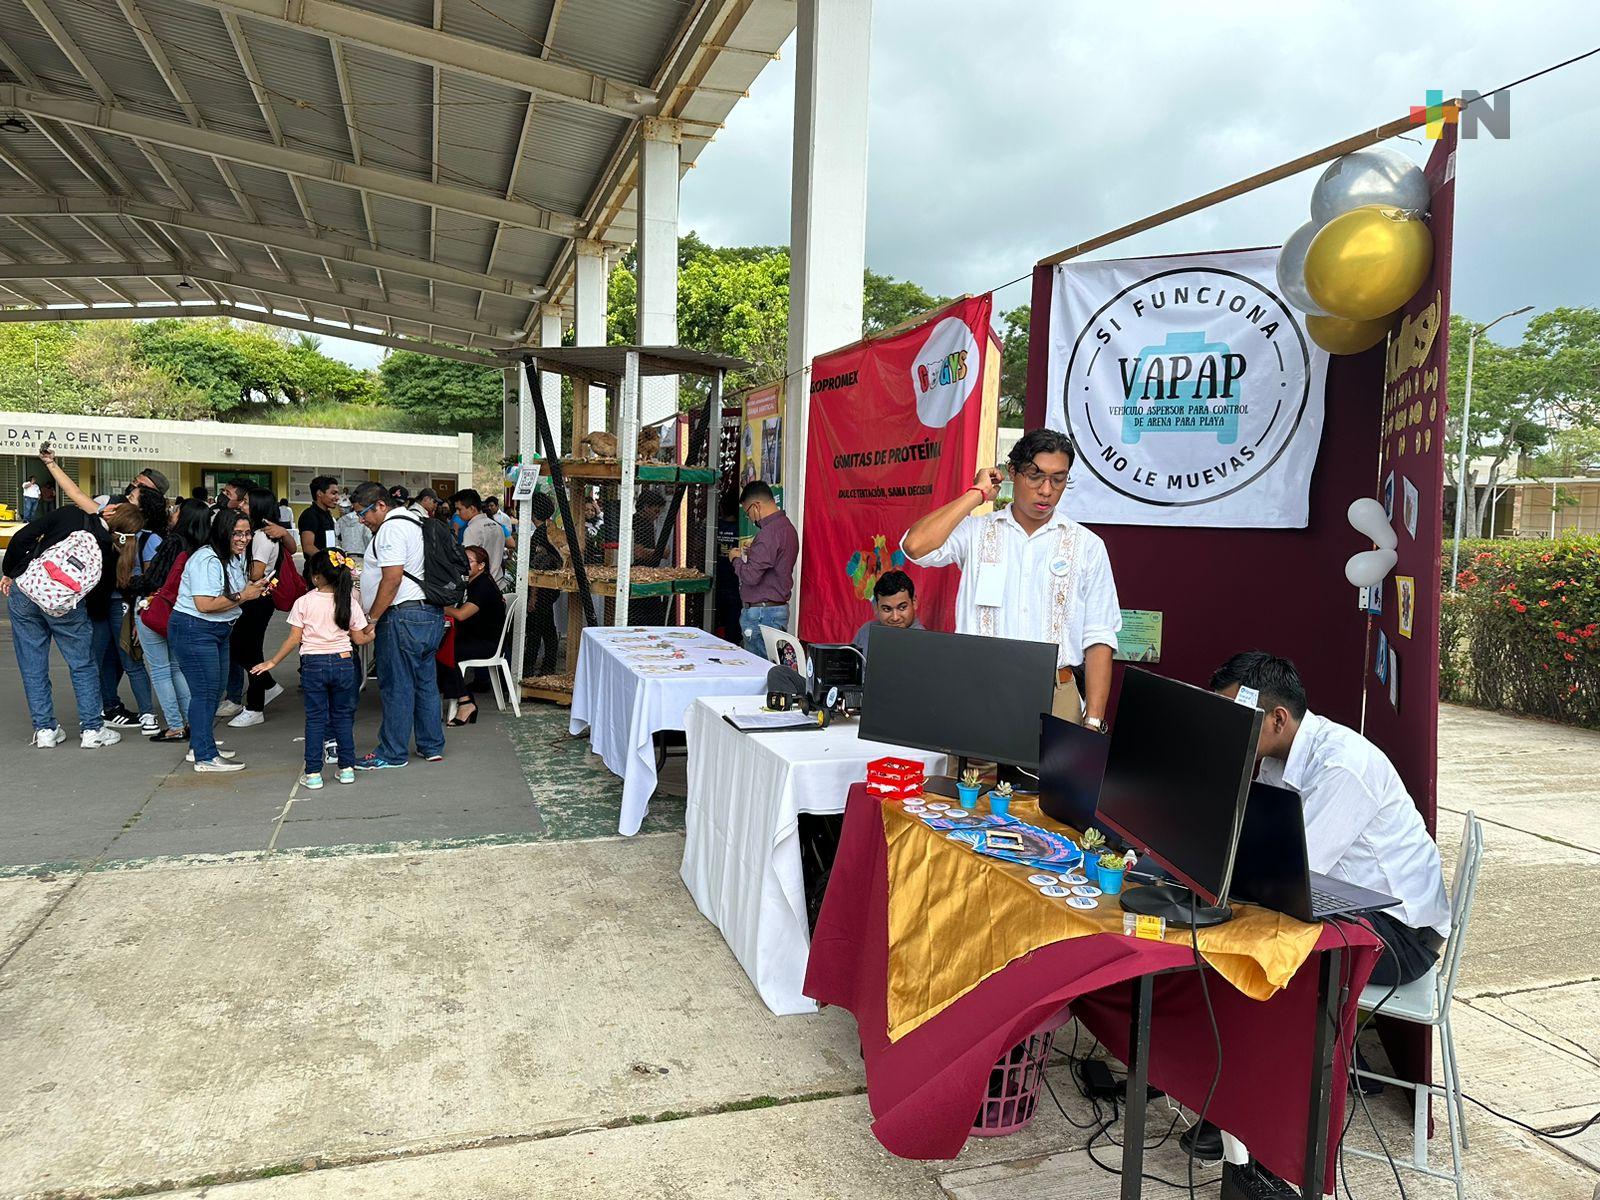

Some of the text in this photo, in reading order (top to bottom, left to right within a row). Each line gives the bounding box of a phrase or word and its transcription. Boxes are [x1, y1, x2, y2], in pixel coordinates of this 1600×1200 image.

[1096, 286, 1280, 345] SI FUNCIONA
[1118, 353, 1247, 400] VAPAP
[1147, 405, 1185, 416] ASPERSOR
[1188, 405, 1209, 415] PARA
[1212, 404, 1249, 415] CONTROL
[1134, 416, 1225, 427] DE ARENA PARA PLAYA
[8, 428, 139, 445] DATA CENTER
[41, 442, 113, 452] OCESAMIENTO
[133, 446, 160, 454] DATOS
[833, 450, 873, 470] GOMITAS
[874, 449, 887, 466] DE
[1100, 445, 1256, 489] NO LE MUEVAS
[888, 486, 907, 498] SANA
